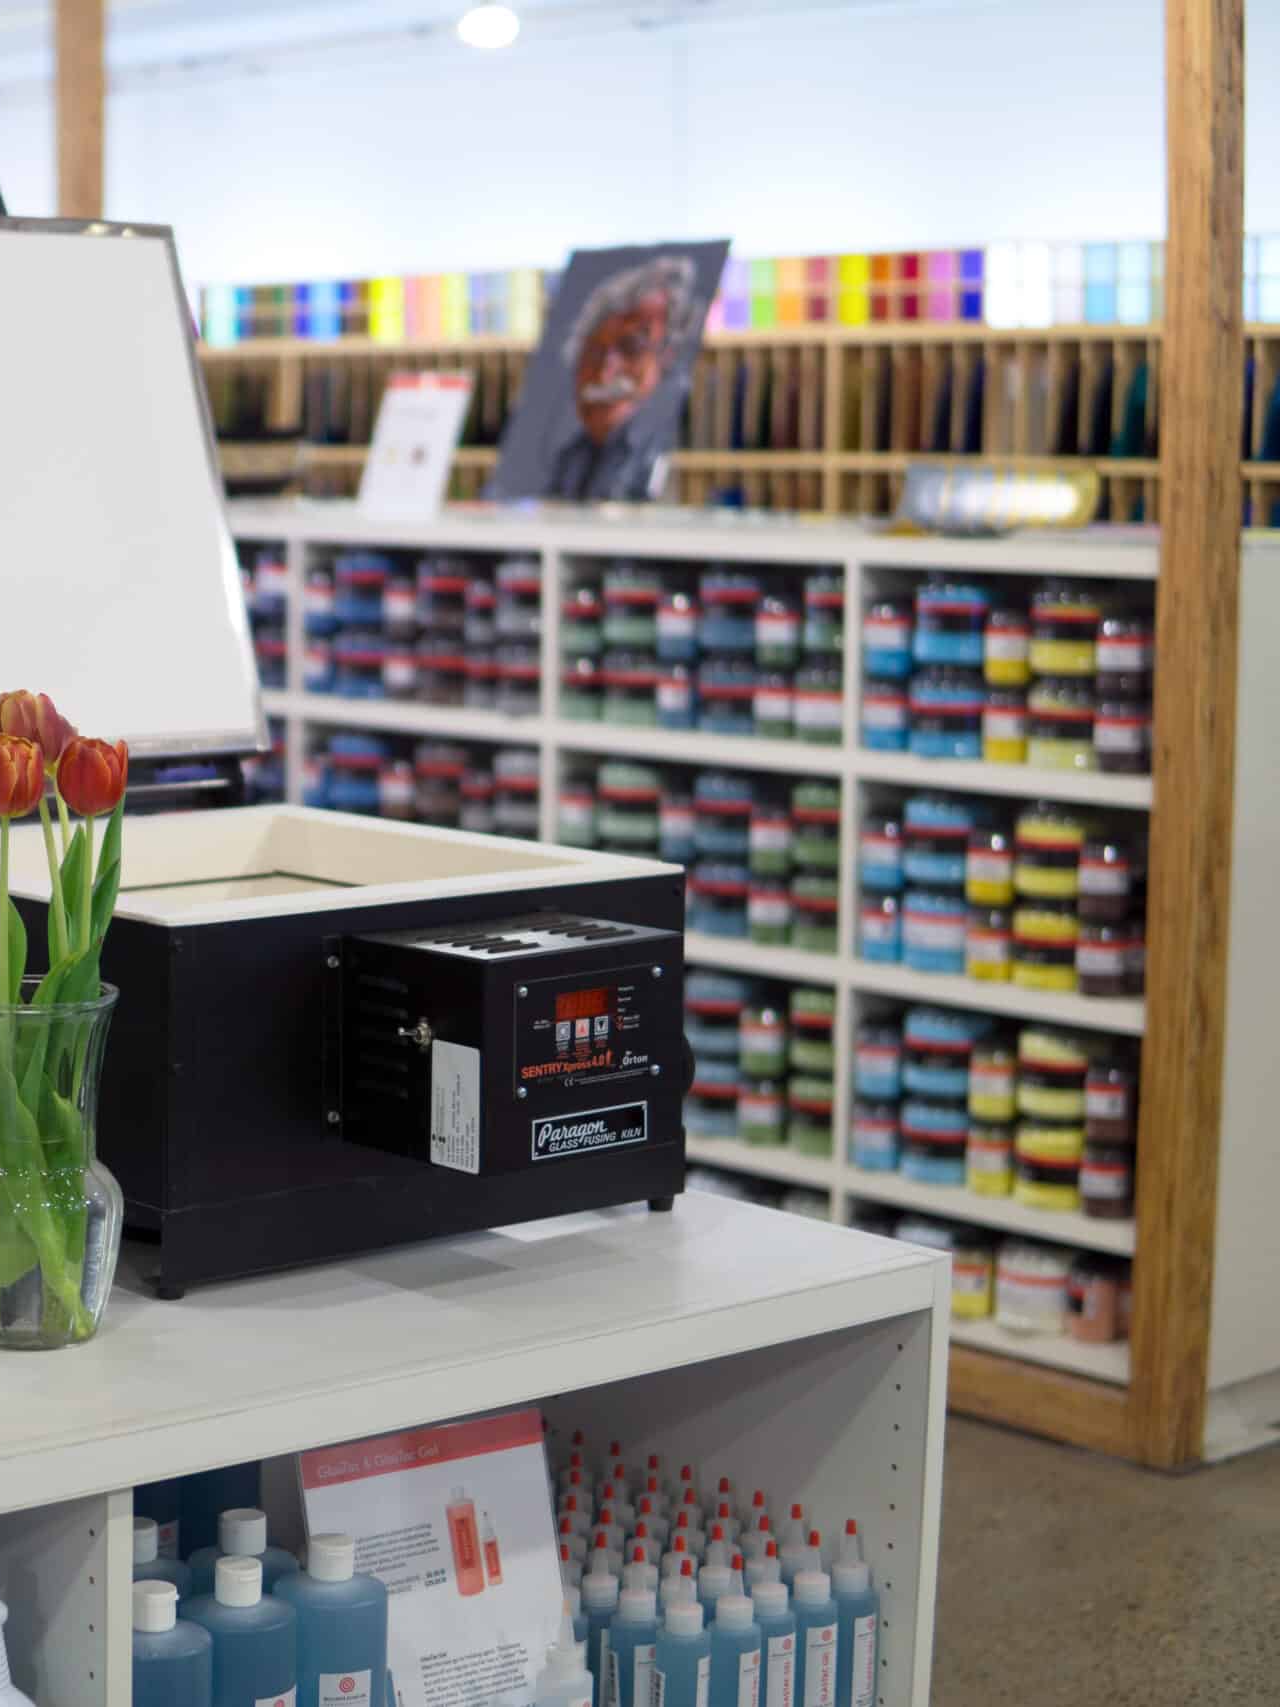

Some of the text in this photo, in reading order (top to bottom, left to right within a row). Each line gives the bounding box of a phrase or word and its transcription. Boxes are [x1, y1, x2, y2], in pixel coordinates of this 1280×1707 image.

[622, 1054, 648, 1065] Orton
[521, 1063, 562, 1080] SENTRY
[538, 1120, 607, 1147] Paragon
[549, 1128, 641, 1152] GLASS FUSING KILN
